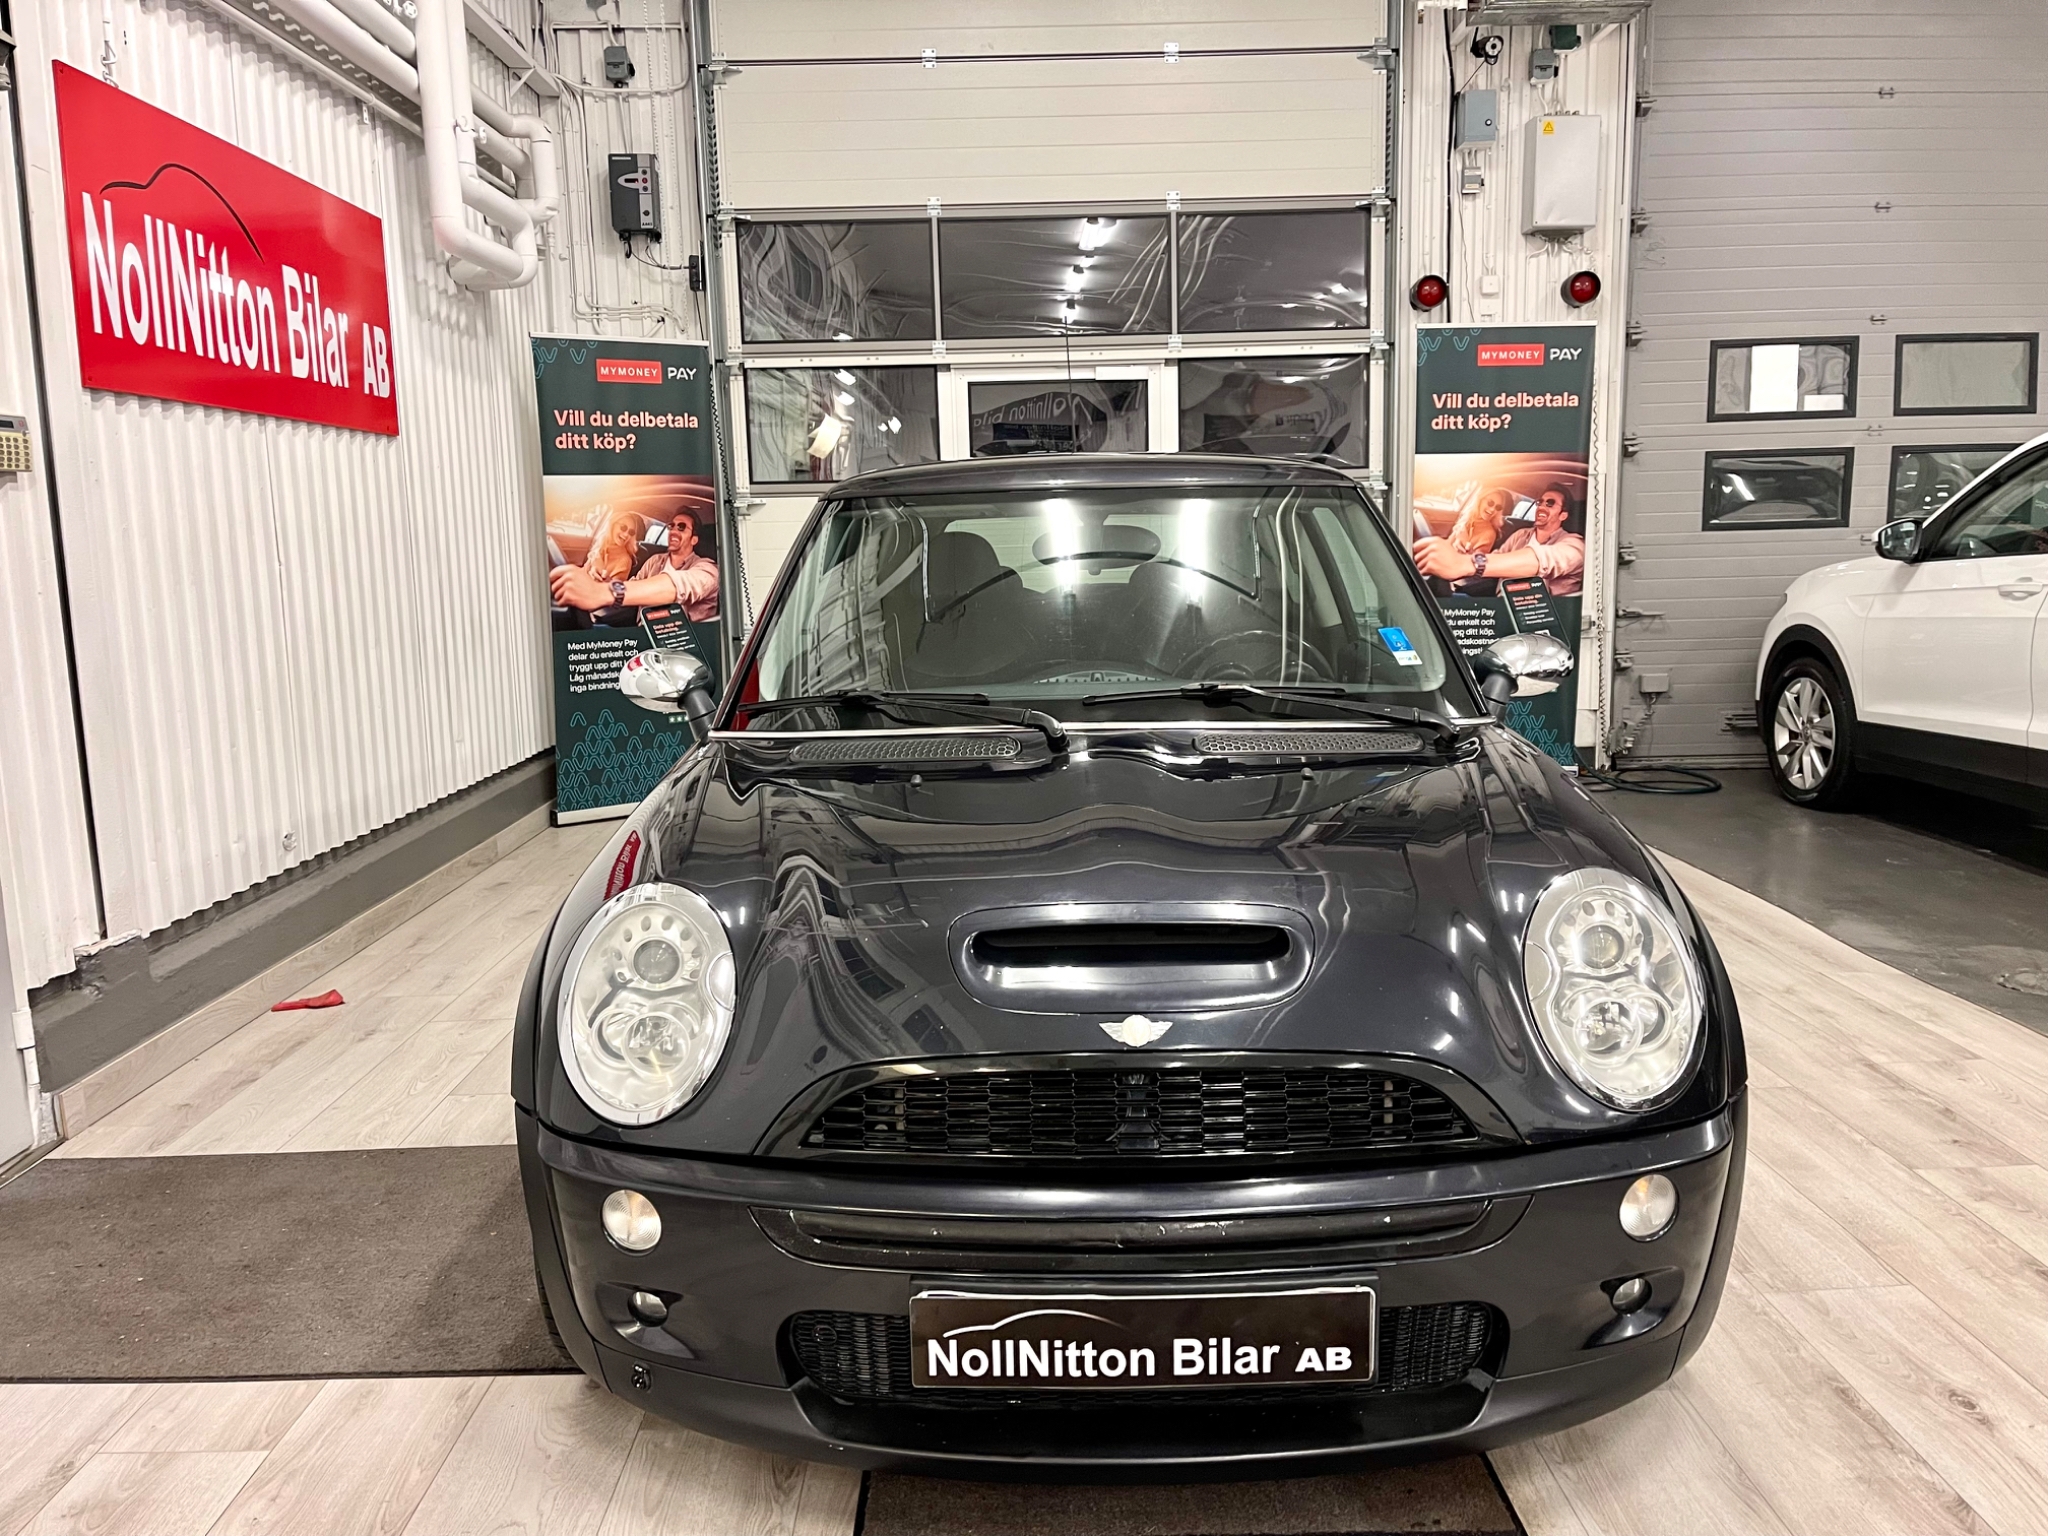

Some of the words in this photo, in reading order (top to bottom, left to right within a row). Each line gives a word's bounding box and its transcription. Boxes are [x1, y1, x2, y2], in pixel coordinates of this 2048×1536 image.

[82, 191, 281, 374] NollNitton
[281, 264, 350, 389] Bilar
[362, 322, 391, 399] AB
[1481, 350, 1541, 360] MYMONEY
[1549, 347, 1583, 361] PAY
[600, 366, 658, 377] MYMONEY
[667, 366, 698, 381] PAY
[1432, 393, 1463, 409] Vill
[1466, 393, 1490, 408] du
[1493, 392, 1580, 408] delbetala
[554, 408, 586, 427] Vill
[589, 410, 613, 427] du
[617, 411, 699, 429] delbetala
[1431, 414, 1464, 430] ditt
[1468, 413, 1512, 433] köp?
[555, 432, 589, 449] ditt
[593, 432, 637, 453] köp?
[1444, 608, 1481, 618] MyMoney
[1481, 608, 1496, 617] Pay
[1457, 618, 1480, 626] enkelt
[1480, 618, 1496, 626] och
[1465, 628, 1479, 636] ditt
[567, 642, 586, 651] Med
[586, 640, 624, 650] MyMoney
[624, 639, 638, 648] Pay
[568, 652, 588, 661] delar
[589, 651, 600, 660] du
[600, 649, 624, 659] enkelt
[624, 648, 639, 657] och
[569, 662, 593, 673] tryggt
[593, 661, 609, 670] upp
[609, 659, 623, 668] ditt
[569, 672, 584, 683] Låg
[569, 683, 587, 694] inga
[587, 681, 621, 691] bindning
[927, 1338, 1156, 1378] NollNitton
[1172, 1337, 1281, 1376] Bilar
[1294, 1346, 1353, 1373] AB
